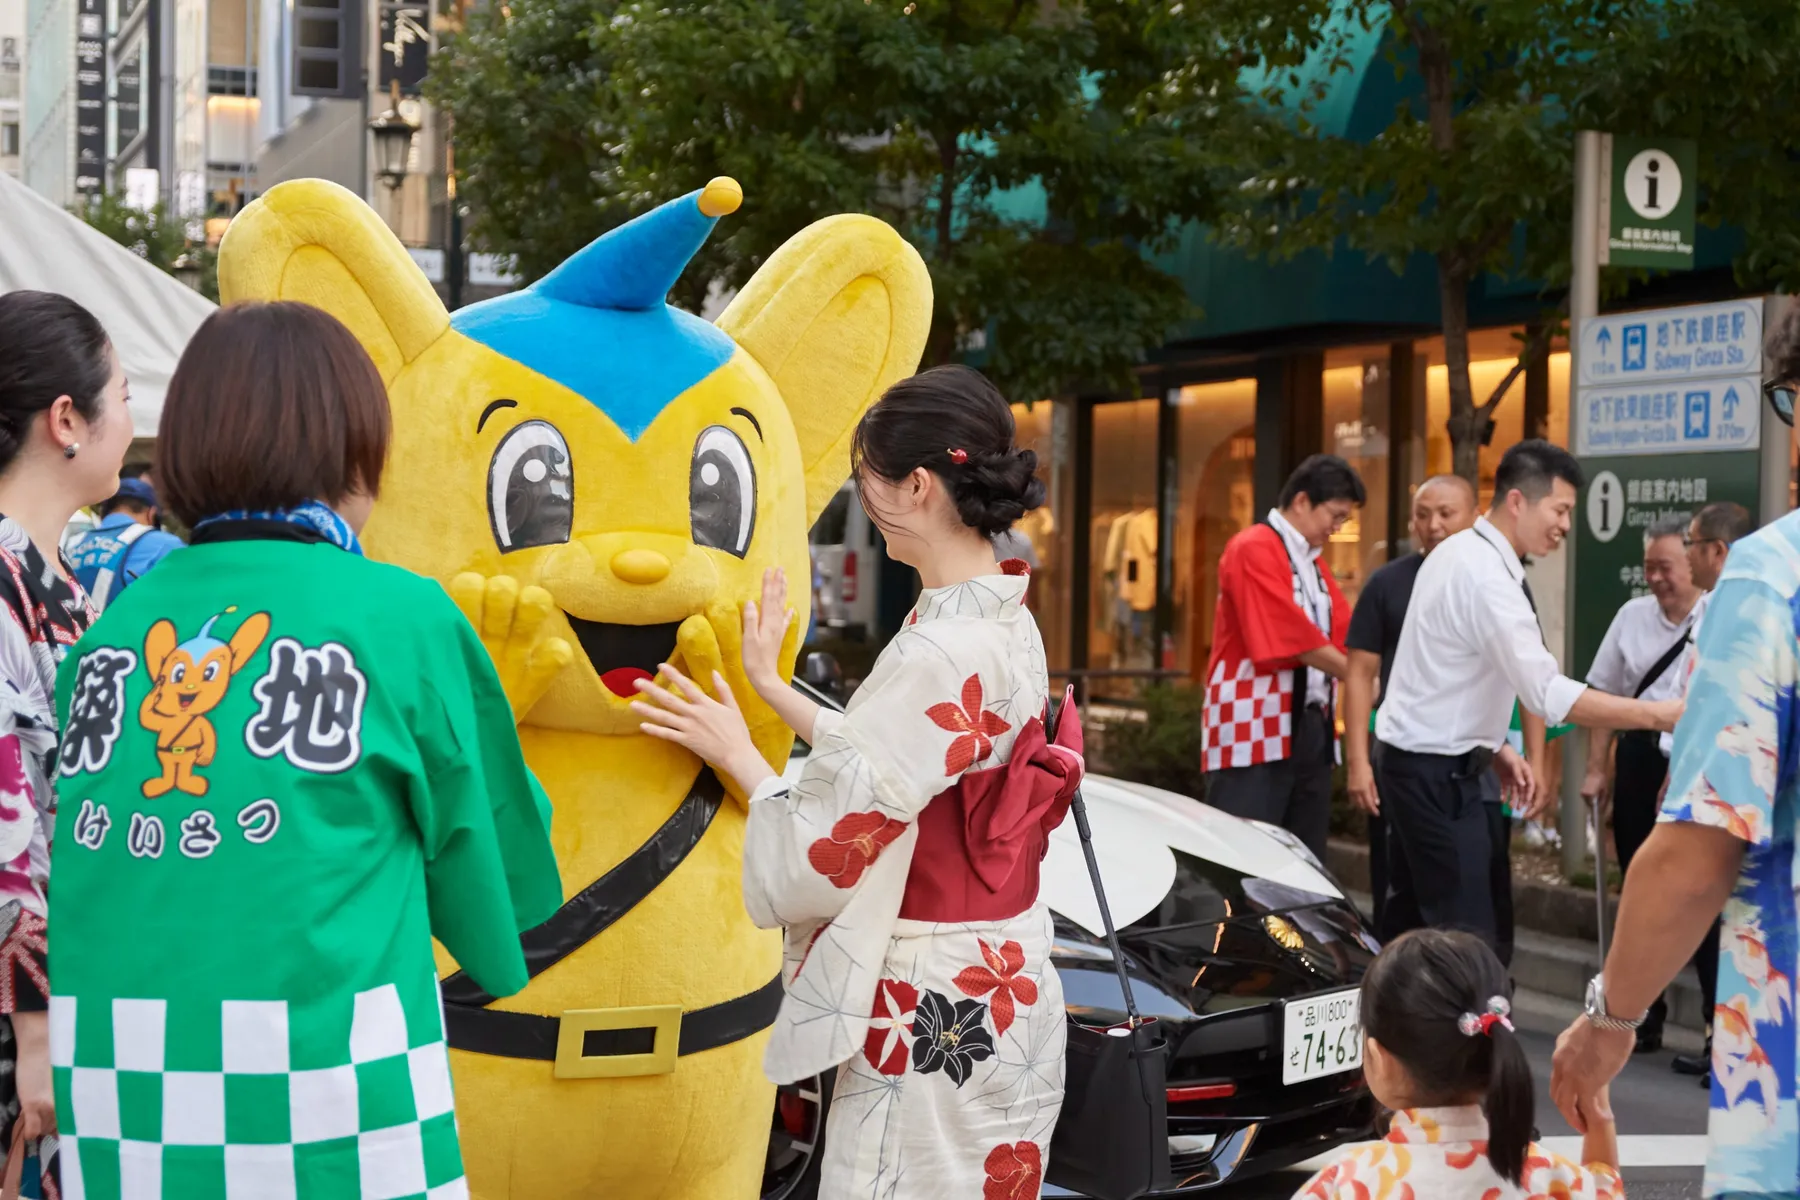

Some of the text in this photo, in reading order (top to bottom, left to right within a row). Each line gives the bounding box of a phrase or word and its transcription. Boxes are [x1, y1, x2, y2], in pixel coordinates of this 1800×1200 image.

[1656, 311, 1745, 347] 地下鉄銀座駅
[1655, 350, 1692, 373] Subway
[1695, 347, 1724, 368] Ginza
[1589, 392, 1678, 423] 地下鉄東銀座駅
[1628, 478, 1707, 503] 銀座案内地図
[60, 637, 368, 777] 築 地
